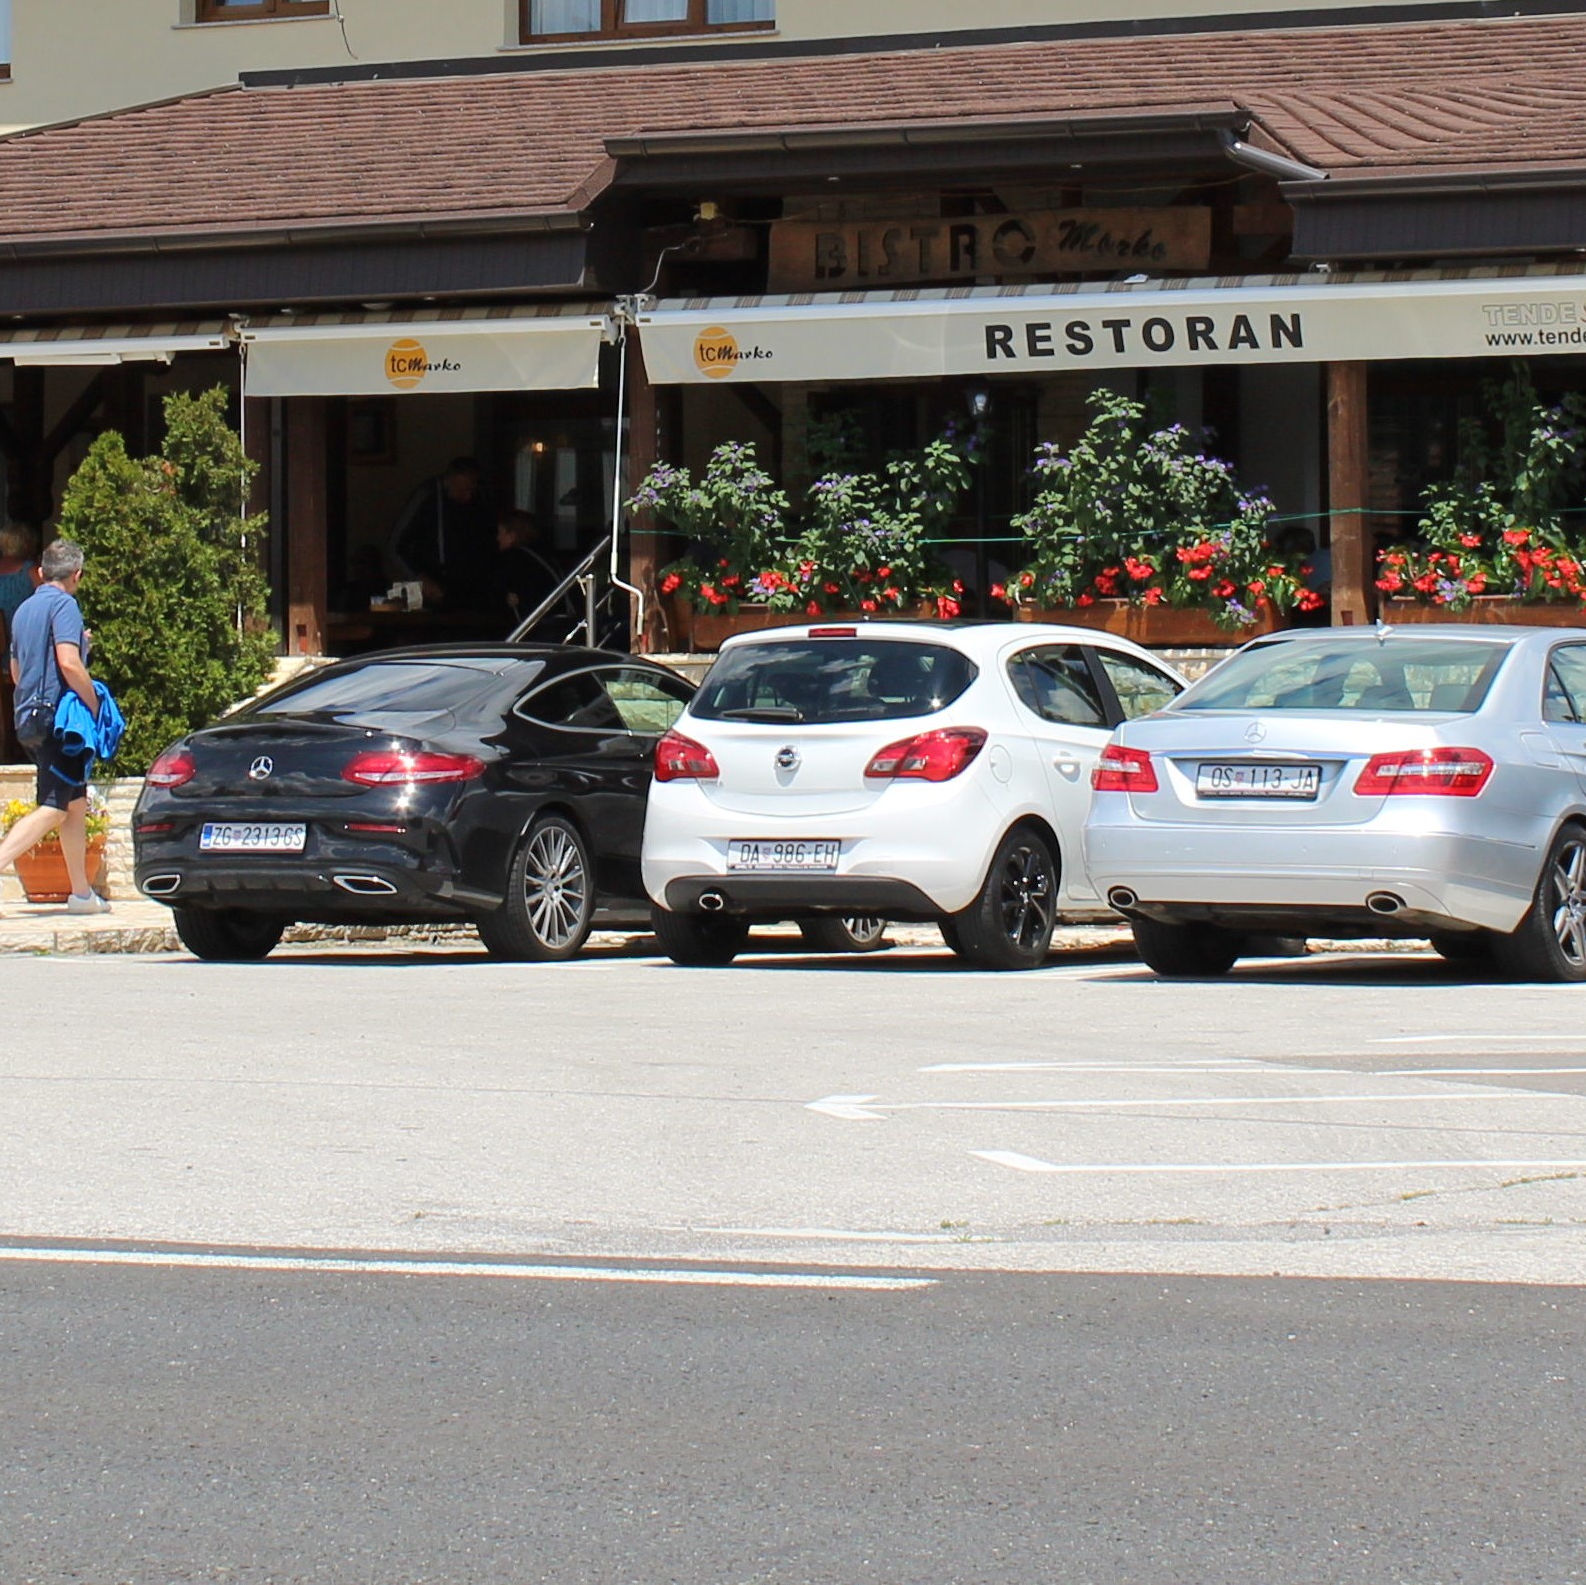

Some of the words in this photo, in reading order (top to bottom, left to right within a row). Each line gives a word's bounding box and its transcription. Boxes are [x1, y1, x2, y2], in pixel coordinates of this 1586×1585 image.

[815, 219, 1037, 280] BISTRO
[984, 312, 1304, 360] RESTORAN
[1481, 301, 1578, 327] TENDE
